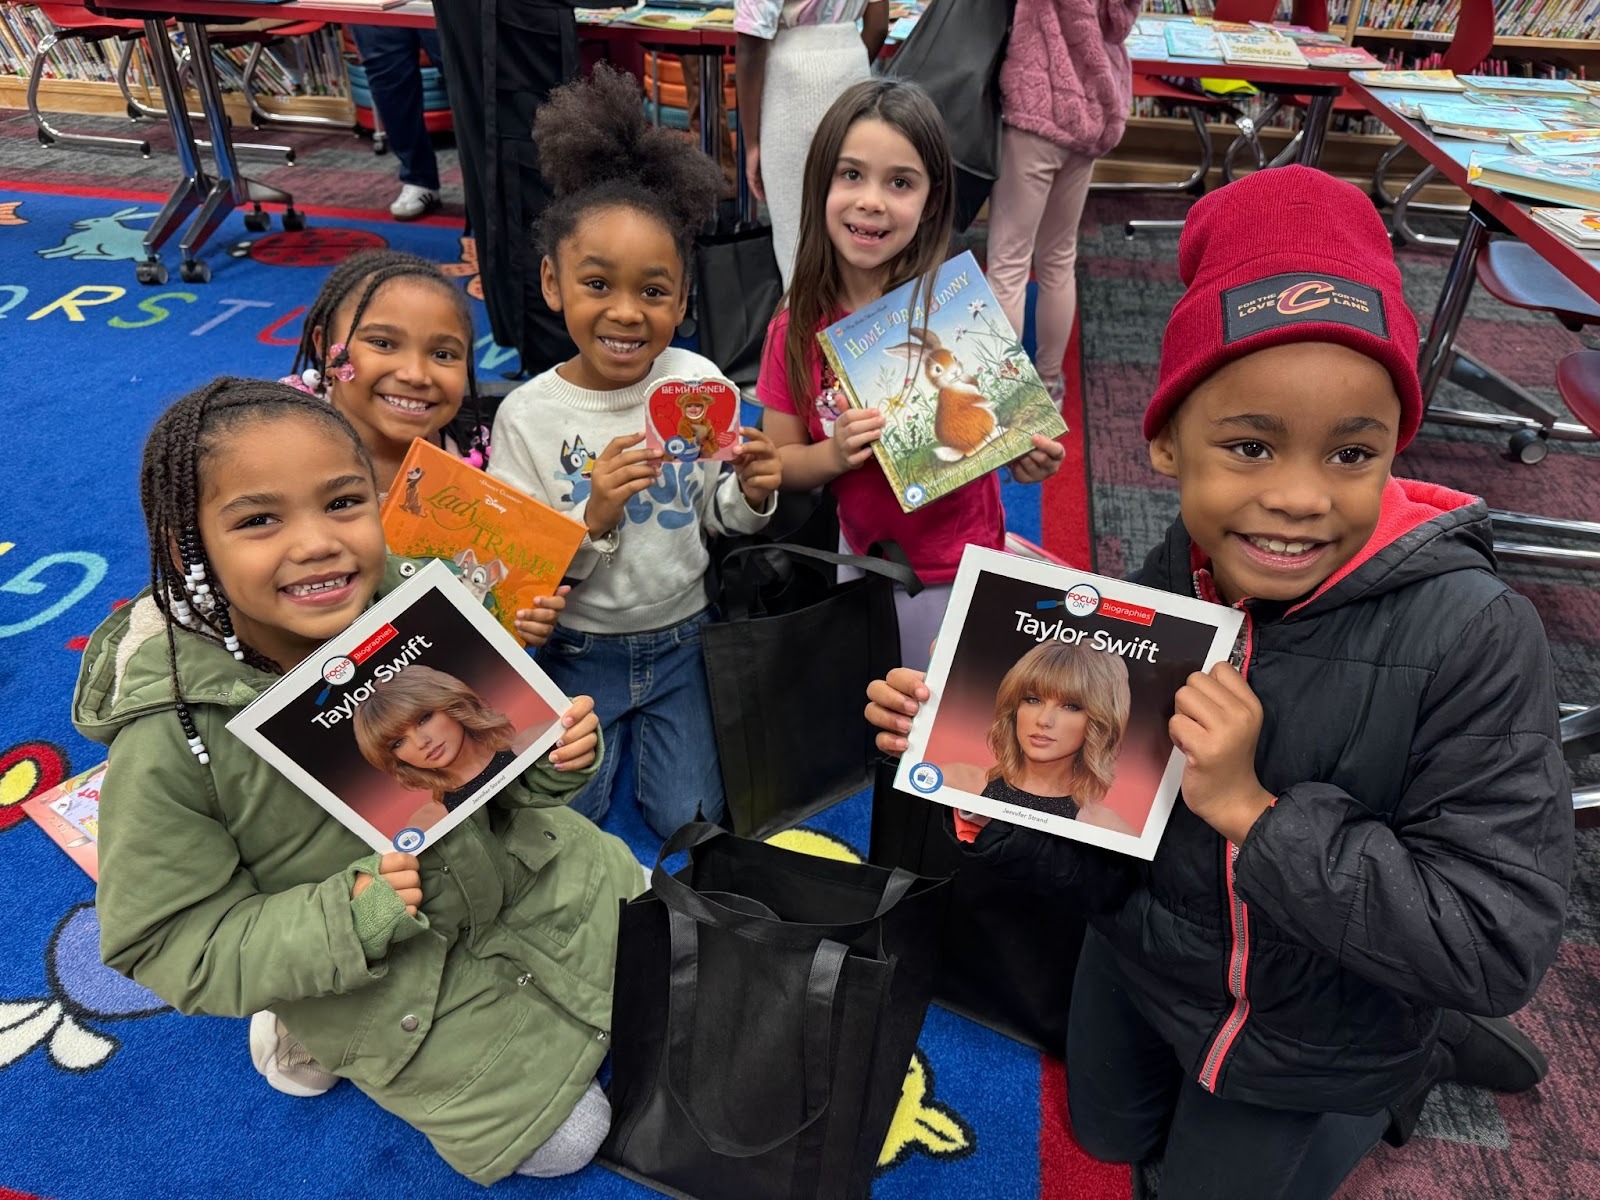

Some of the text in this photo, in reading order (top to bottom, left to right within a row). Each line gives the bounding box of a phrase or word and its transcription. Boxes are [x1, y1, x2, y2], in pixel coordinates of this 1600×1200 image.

[1238, 293, 1277, 310] FOR THE
[1239, 300, 1275, 317] LOVE
[1332, 291, 1367, 306] FOR THE
[1333, 297, 1370, 313] LAND
[26, 285, 127, 321] R
[107, 292, 198, 329] S
[189, 299, 275, 336] T
[844, 321, 886, 360] HOME
[885, 308, 910, 328] FOR
[915, 306, 925, 322] A
[928, 271, 969, 315] BUNNY
[661, 385, 674, 394] BE
[692, 385, 726, 394] HONEY
[426, 485, 482, 530] Lady
[470, 522, 556, 579] TRAMP
[1068, 592, 1098, 606] FOCUS
[1102, 602, 1151, 620] Biographies
[353, 627, 393, 660] Biographies
[1014, 610, 1160, 663] Taylor Swift
[325, 659, 351, 681] FOCUS
[311, 634, 433, 729] Taylor Swift
[1002, 807, 1049, 824] Jennifer Strand
